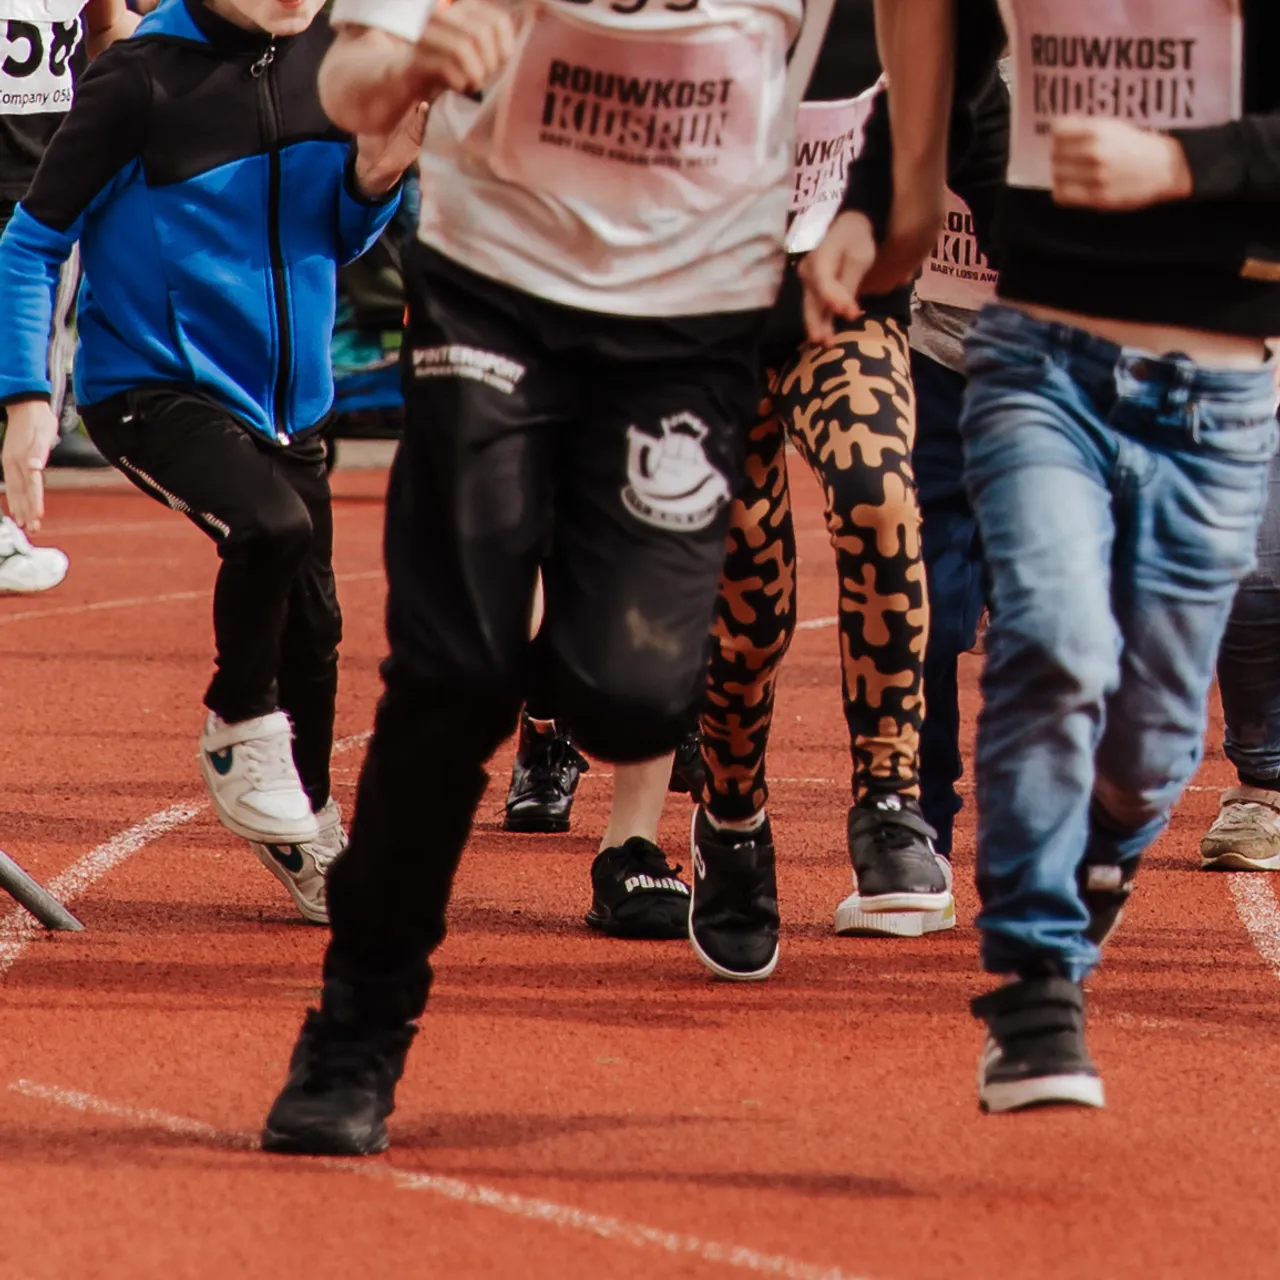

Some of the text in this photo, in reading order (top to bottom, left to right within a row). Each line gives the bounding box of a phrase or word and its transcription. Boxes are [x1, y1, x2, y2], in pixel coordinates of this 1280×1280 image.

[1031, 34, 1195, 71] ROUWKOST
[0, 86, 49, 107] ompany
[549, 60, 733, 108] ROUWKOST
[956, 268, 979, 280] LOSS
